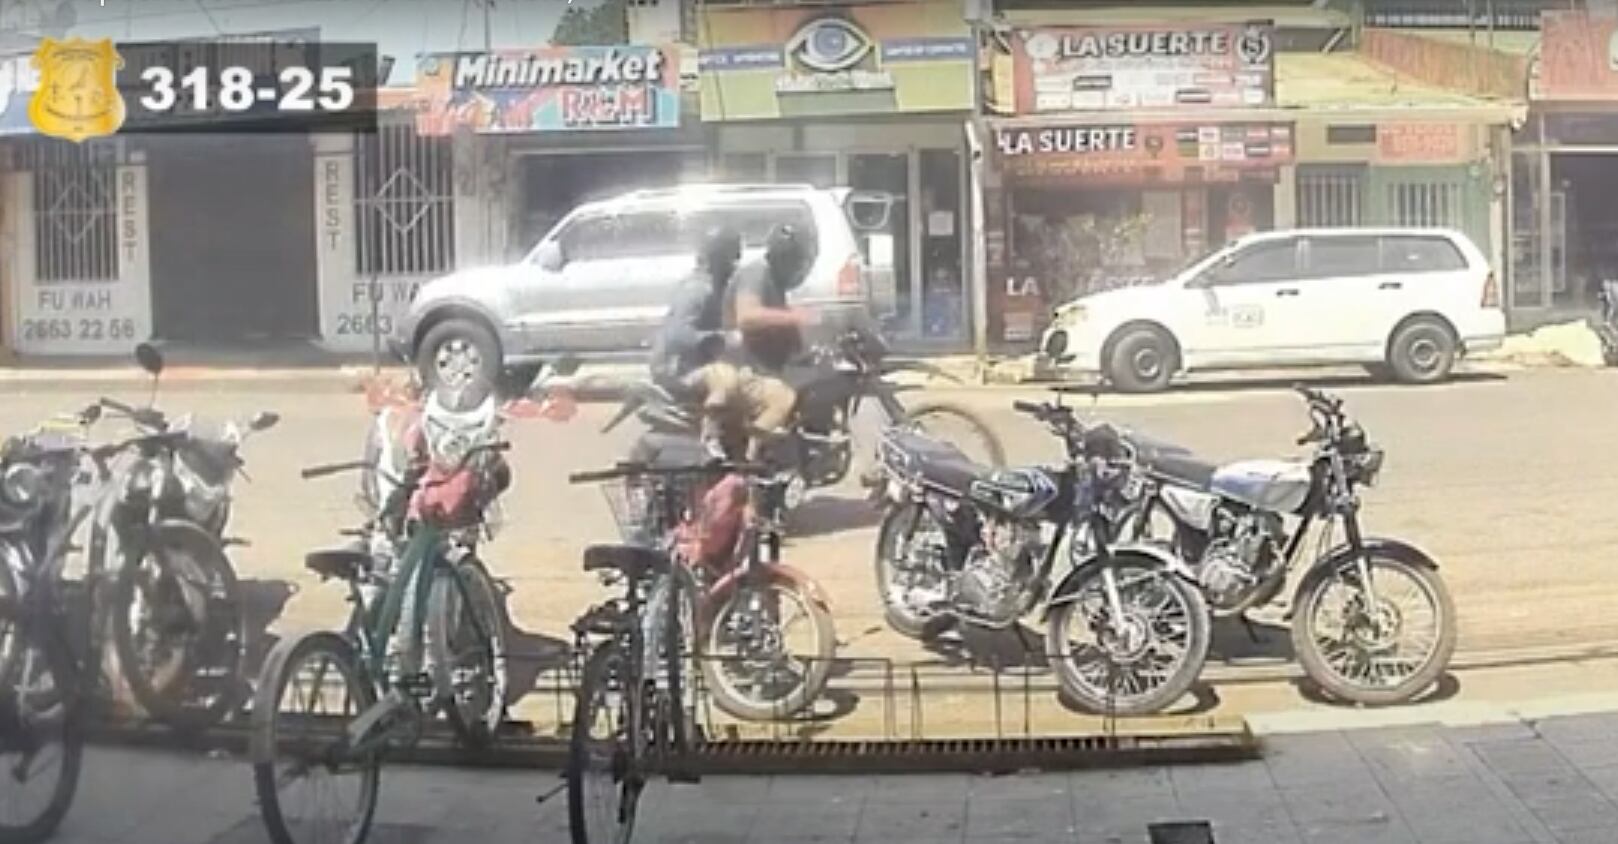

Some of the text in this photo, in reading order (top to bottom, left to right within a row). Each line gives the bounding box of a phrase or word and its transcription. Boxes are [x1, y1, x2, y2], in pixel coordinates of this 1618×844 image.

[1062, 35, 1099, 56] LA
[1105, 31, 1231, 54] SUERTE
[455, 50, 662, 87] Minimarket
[1001, 128, 1136, 155] LA SUERTE
[121, 171, 138, 262] REST
[325, 161, 341, 251] REST
[38, 290, 64, 310] FU
[351, 281, 384, 303] FU
[79, 317, 104, 339] 22
